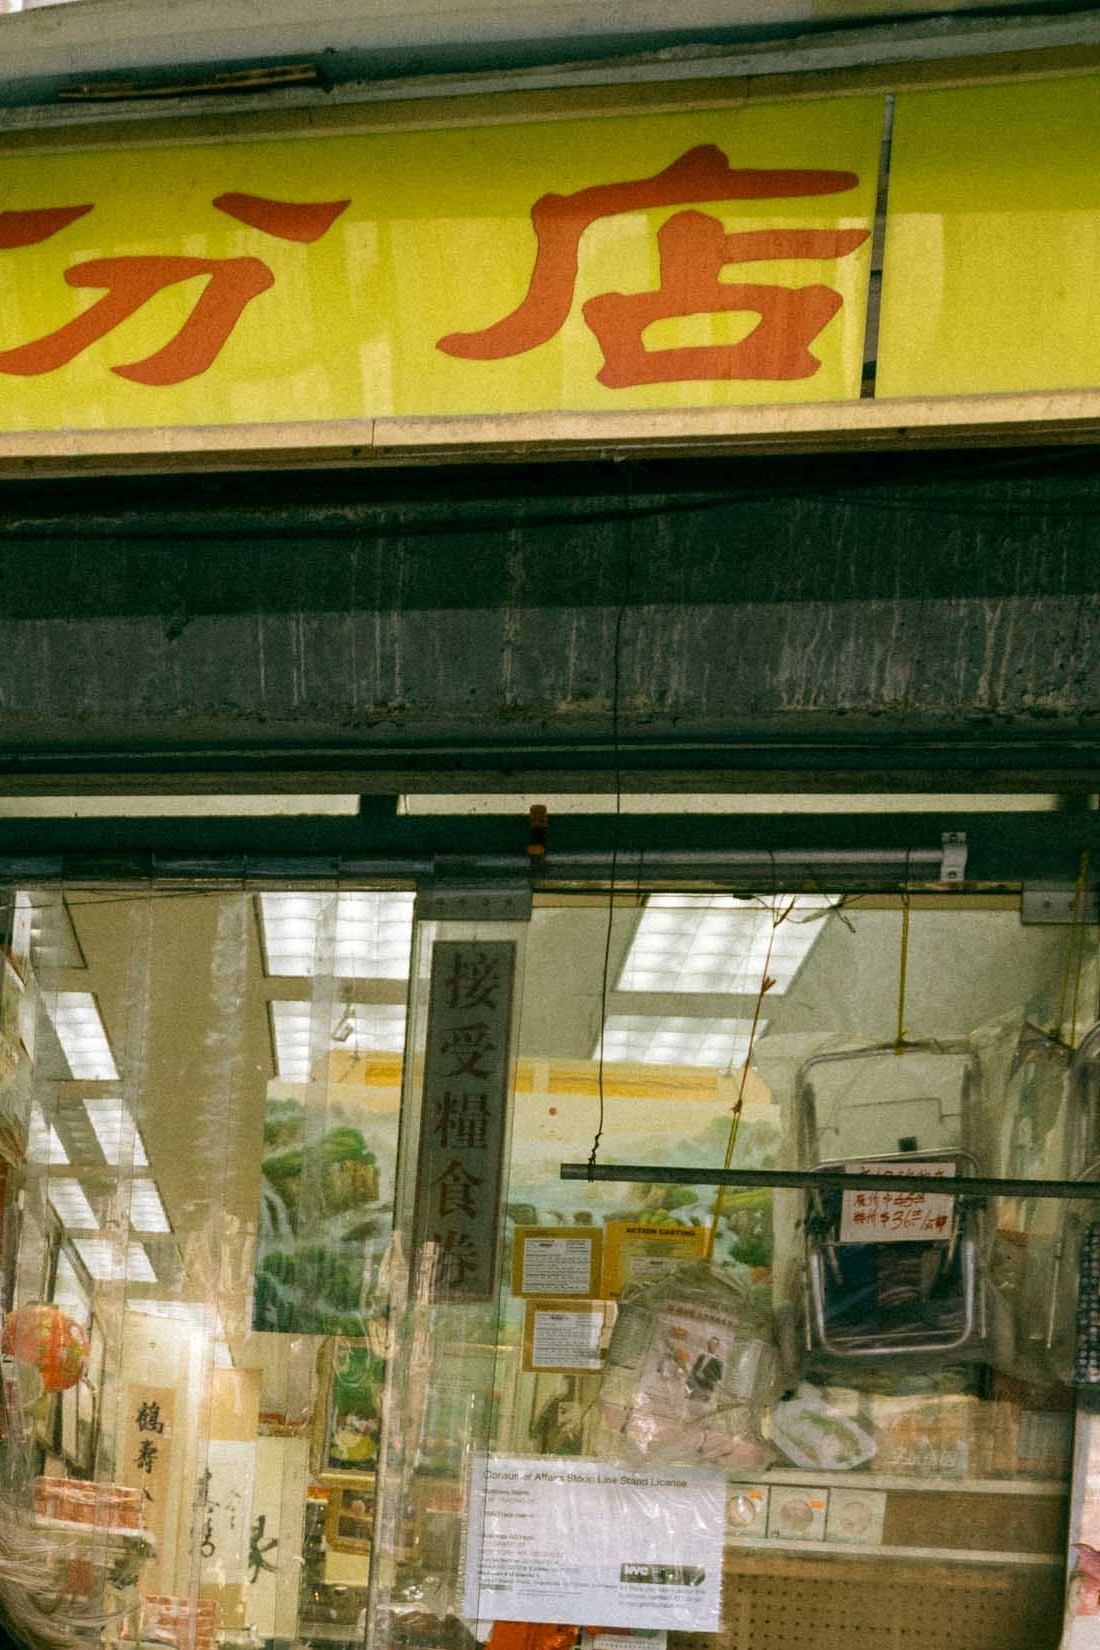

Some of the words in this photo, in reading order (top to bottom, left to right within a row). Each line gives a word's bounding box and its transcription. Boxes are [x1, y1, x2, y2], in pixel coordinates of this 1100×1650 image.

[626, 1227, 657, 1236] ACTION
[598, 1475, 618, 1484] Line
[620, 1476, 649, 1487] Stand
[651, 1477, 688, 1488] License
